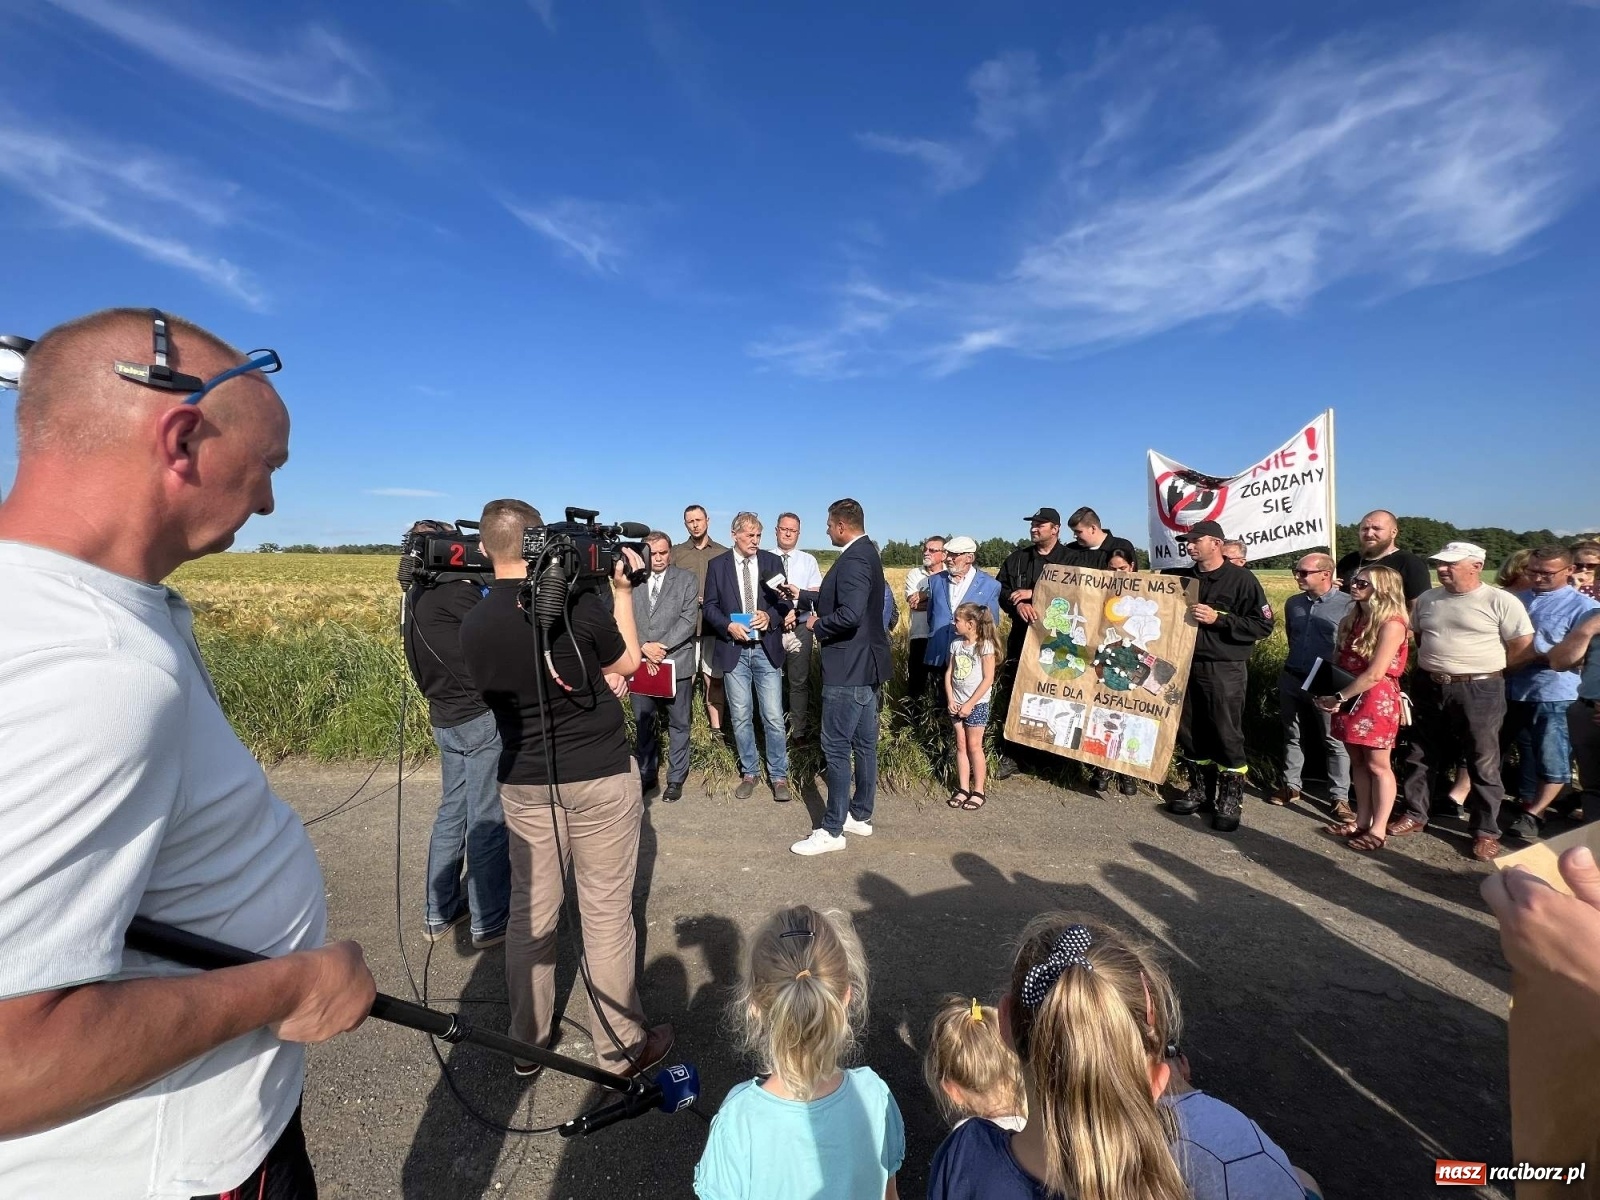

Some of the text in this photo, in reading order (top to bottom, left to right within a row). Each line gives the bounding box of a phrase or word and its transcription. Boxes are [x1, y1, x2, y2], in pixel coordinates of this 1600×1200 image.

[1251, 426, 1319, 478] NIE !
[1240, 467, 1325, 499] ZGADZAMY
[1262, 496, 1293, 514] SIĘ
[449, 543, 465, 567] 2
[588, 543, 596, 571] 1
[1155, 544, 1172, 559] NA
[1040, 569, 1057, 582] NIE
[1061, 572, 1142, 596] ZATRUWAJCIE
[1147, 579, 1177, 595] NAS
[1037, 681, 1171, 718] NIE DLA ASFALTOWNI
